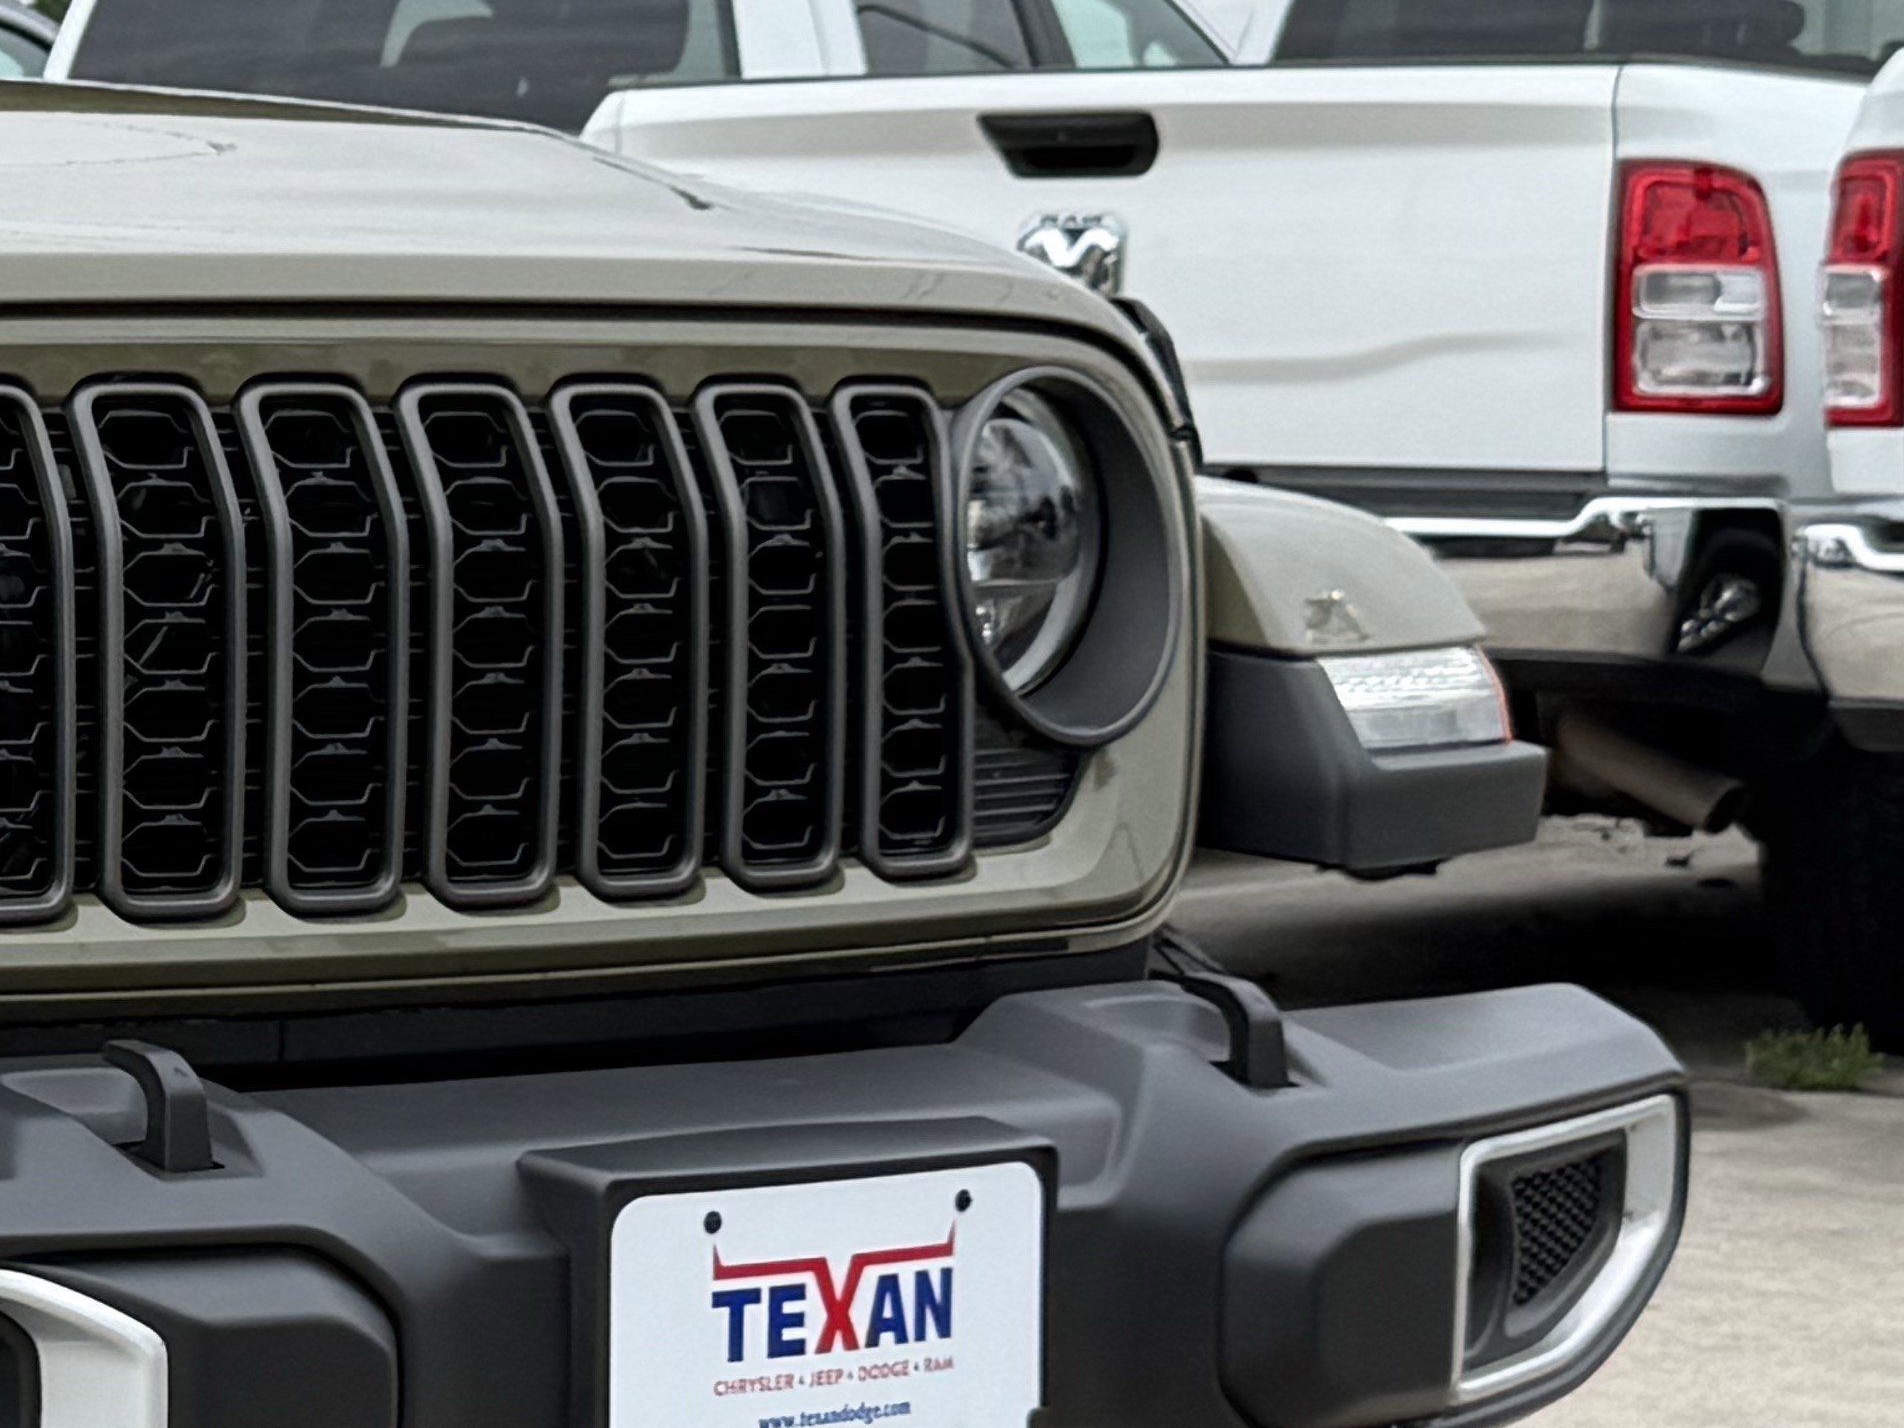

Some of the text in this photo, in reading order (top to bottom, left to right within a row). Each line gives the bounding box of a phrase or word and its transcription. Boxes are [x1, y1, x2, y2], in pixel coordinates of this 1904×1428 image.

[711, 1253, 955, 1362] TEXAN
[713, 1355, 955, 1397] CHRYSLER JEEP DODGE RAM
